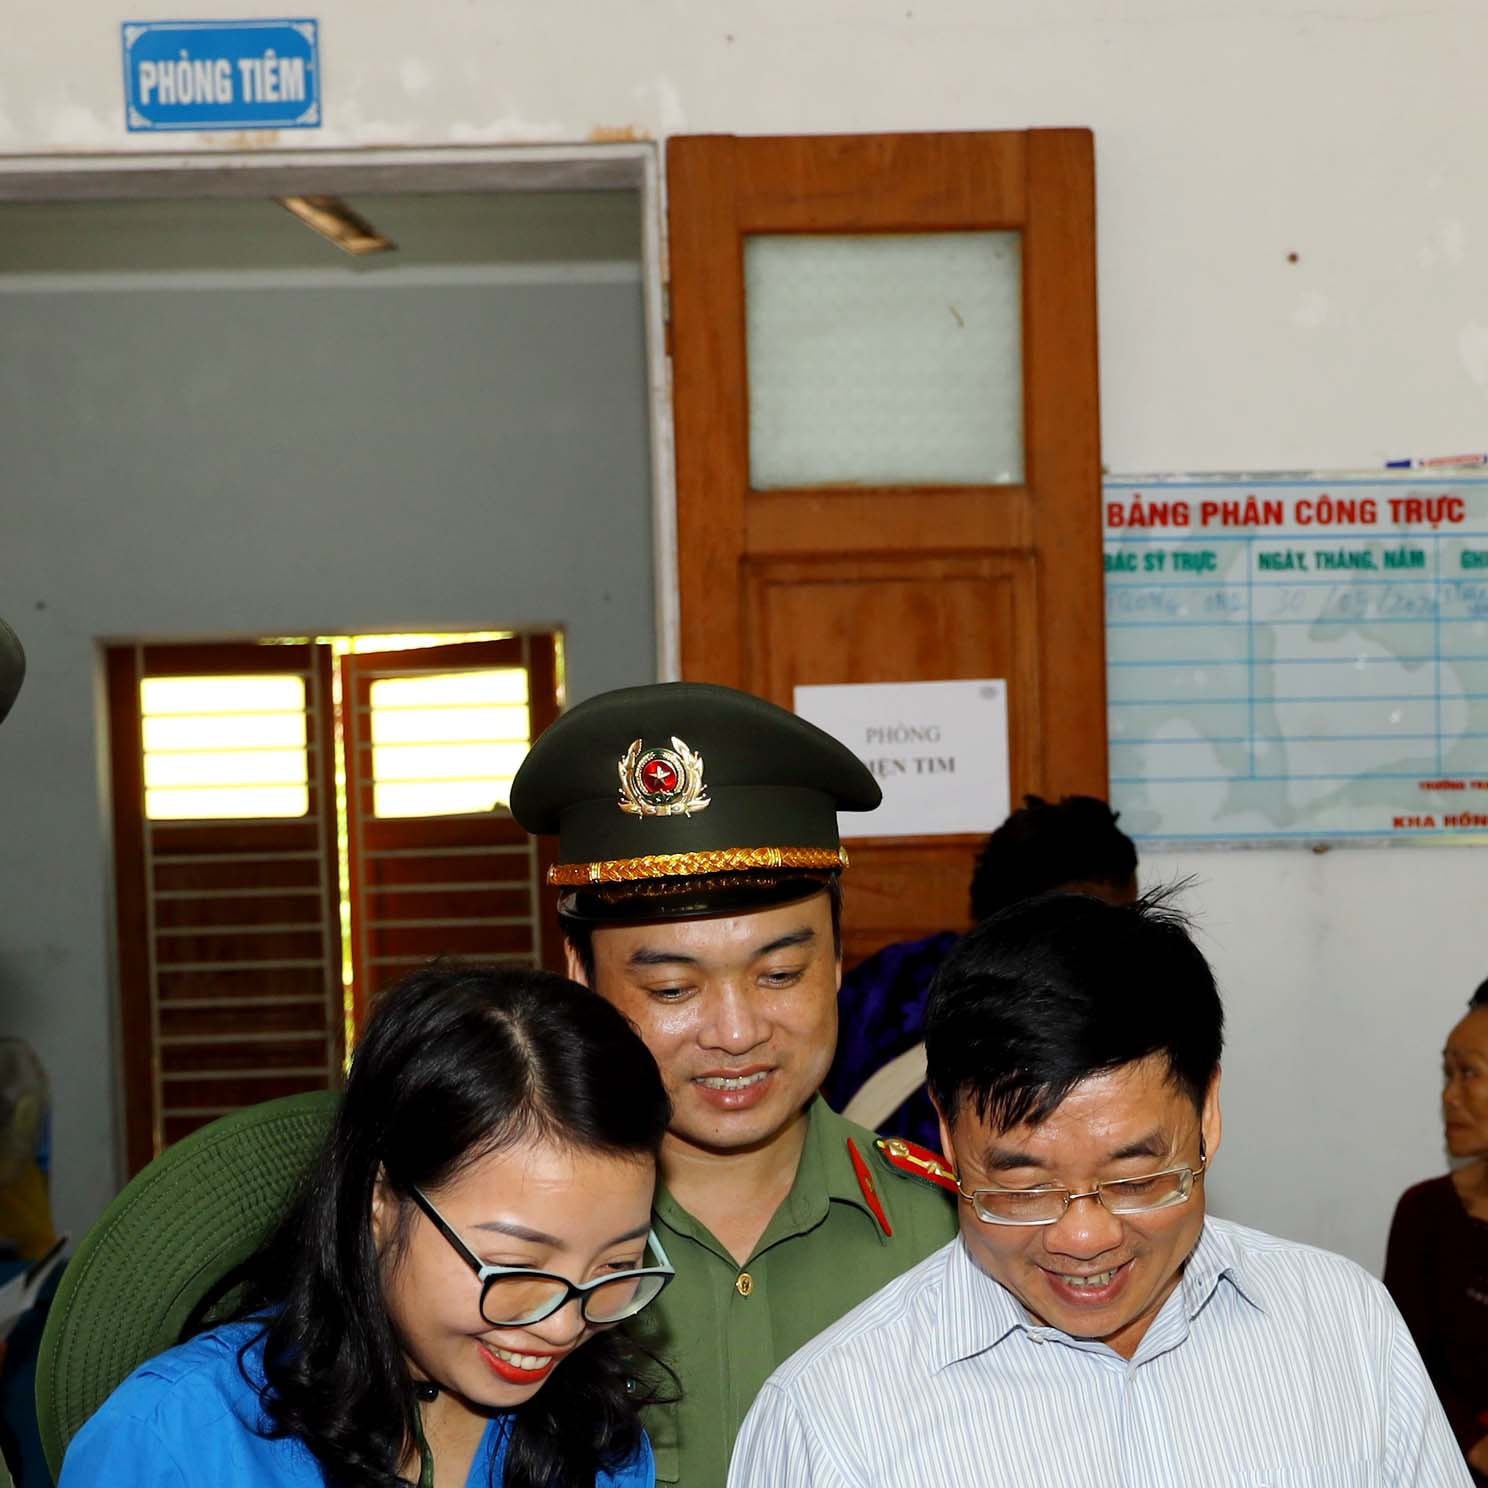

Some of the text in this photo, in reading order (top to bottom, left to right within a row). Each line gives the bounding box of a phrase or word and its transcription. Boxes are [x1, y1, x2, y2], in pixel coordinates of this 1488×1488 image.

[139, 48, 306, 105] PHÒNG TIÊM
[1107, 493, 1465, 530] BẢNG PHÂN CÔNG TRỰC
[1103, 549, 1137, 573] BÁC
[1172, 550, 1217, 575] TRỰC
[1383, 543, 1425, 569] NĂM
[865, 721, 941, 744] PHÒNG
[914, 756, 956, 775] TIM
